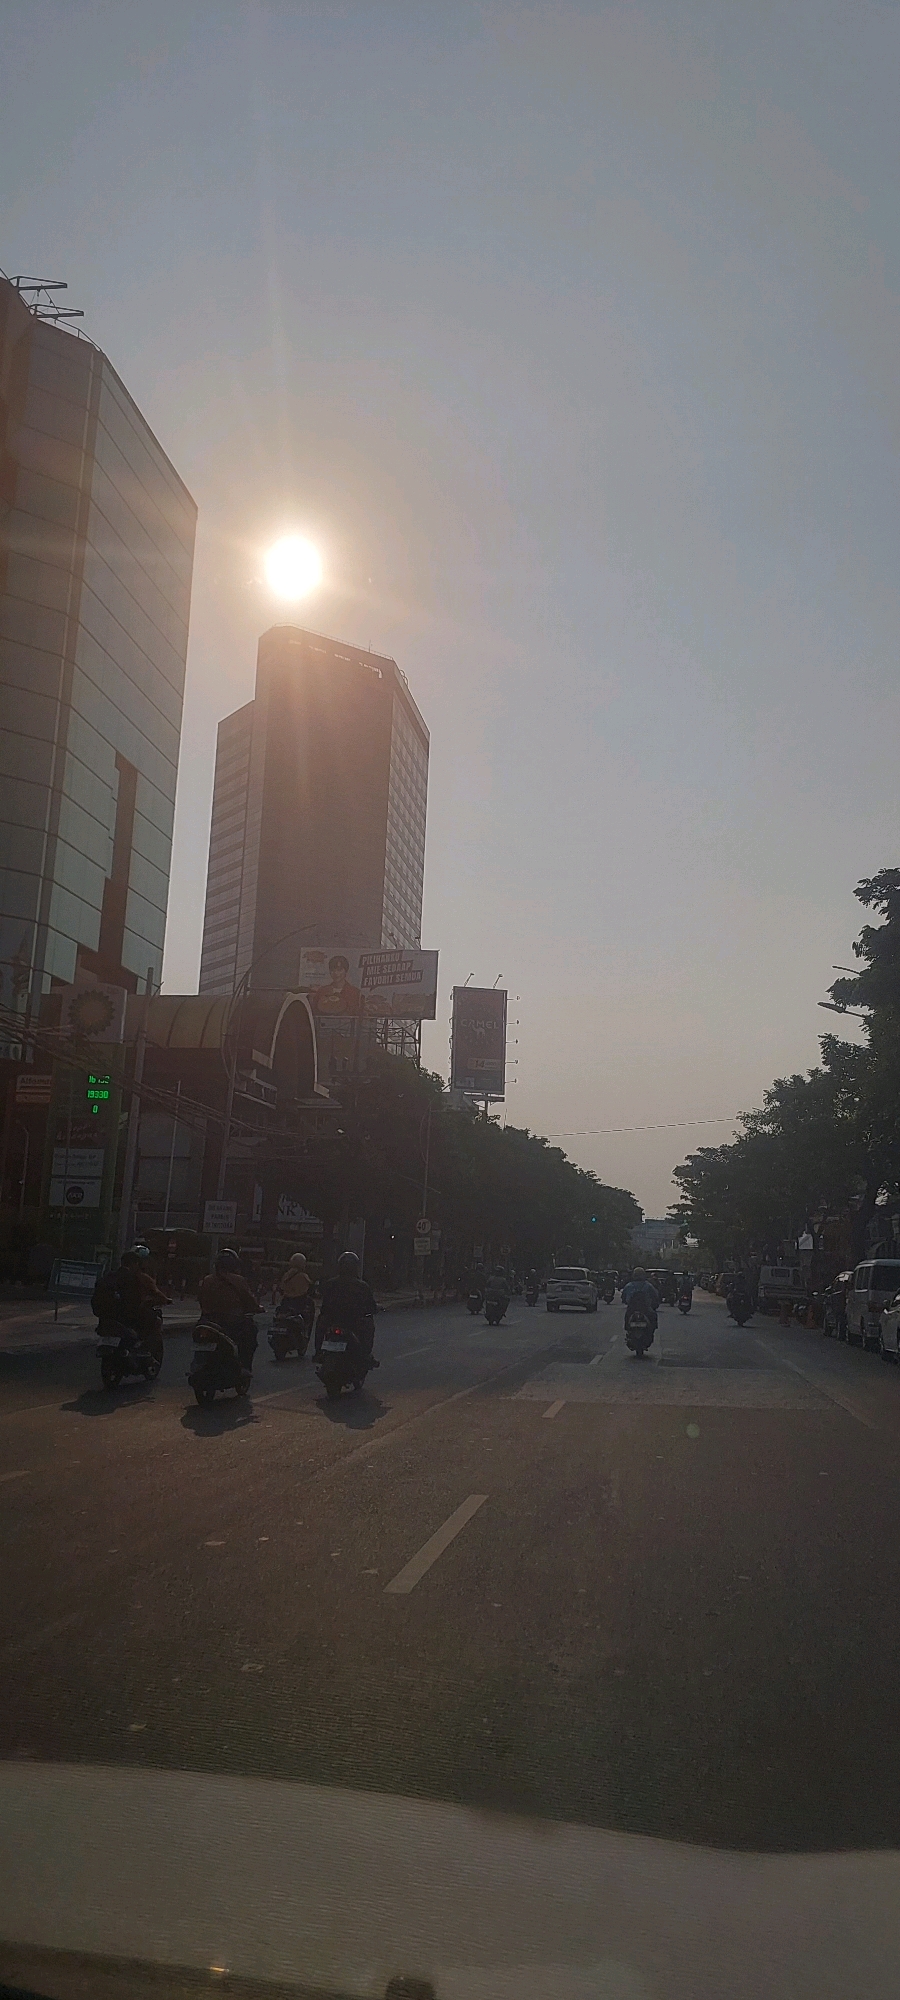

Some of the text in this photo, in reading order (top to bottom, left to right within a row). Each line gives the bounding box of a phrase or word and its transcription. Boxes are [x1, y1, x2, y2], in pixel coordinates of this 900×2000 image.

[362, 952, 400, 966] PILIHANKU
[366, 962, 411, 975] MIE SEDAAP
[363, 971, 421, 986] FAVORIT SEMUA
[460, 1018, 499, 1029] CAMEL
[92, 1105, 98, 1113] 0
[417, 1222, 427, 1231] 40
